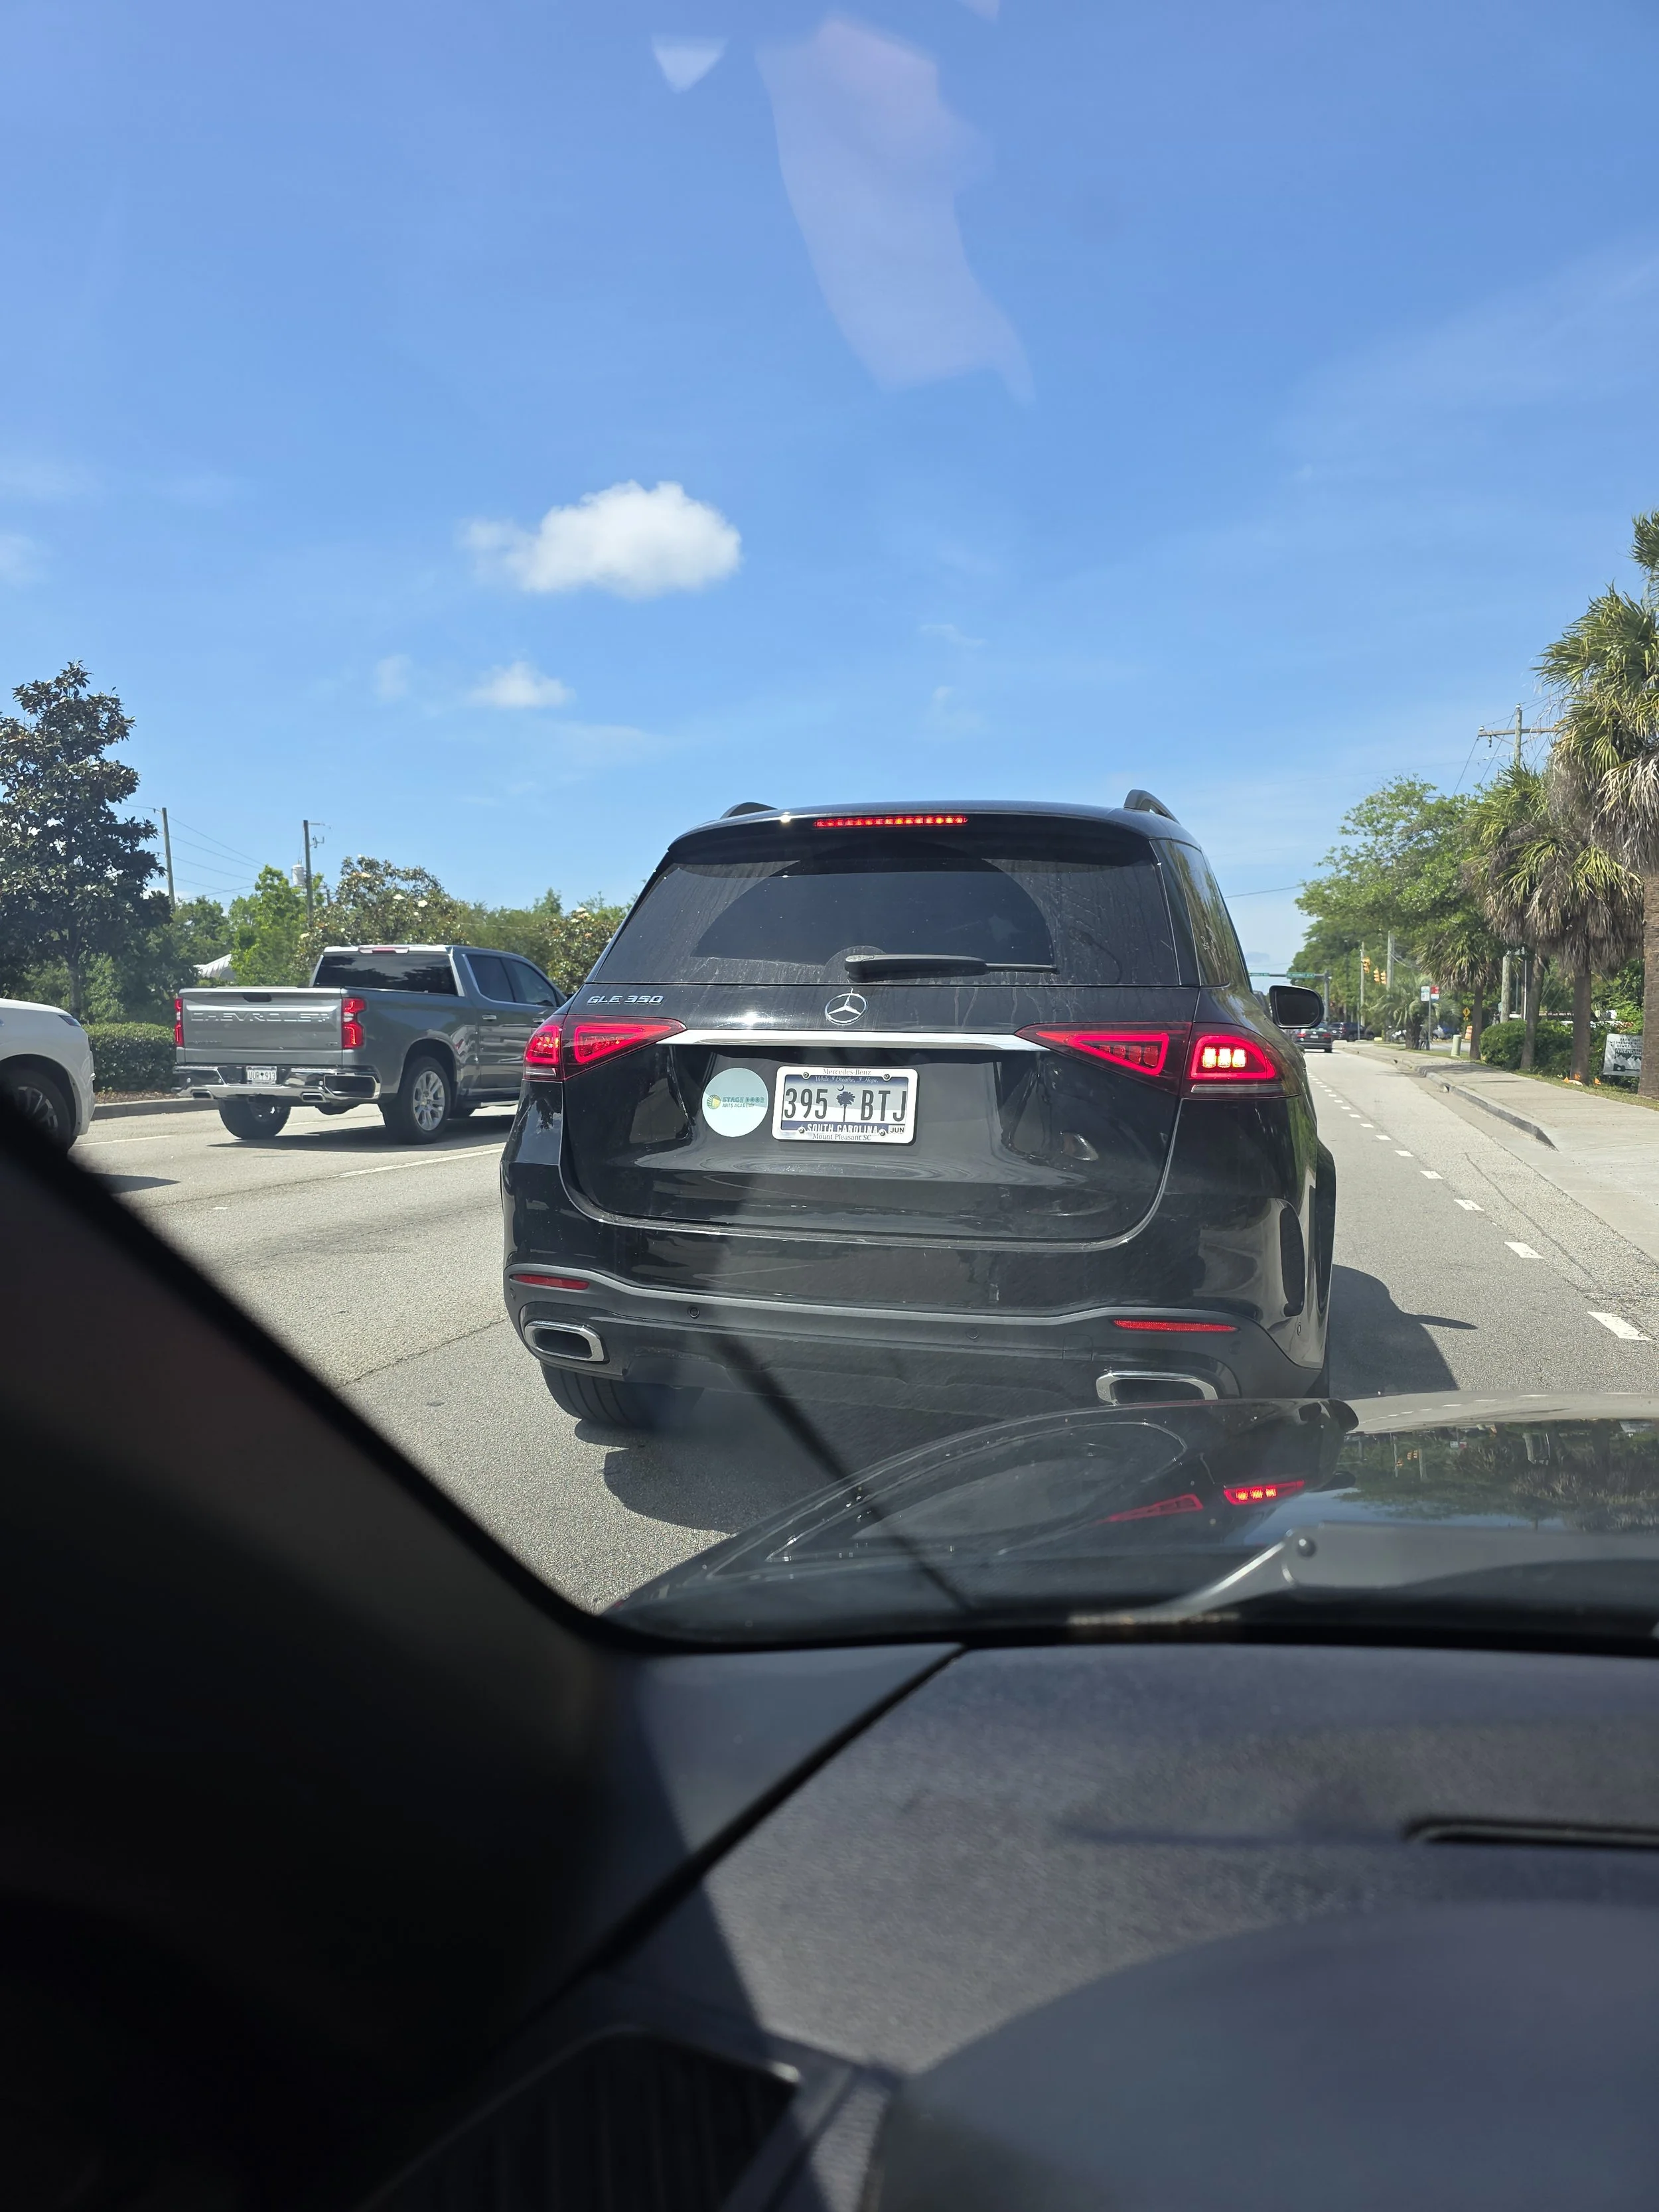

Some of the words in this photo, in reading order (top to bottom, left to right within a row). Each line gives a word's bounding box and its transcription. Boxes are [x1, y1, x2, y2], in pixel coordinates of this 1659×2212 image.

[587, 995, 623, 1004] GLE
[624, 995, 664, 1004] 350
[191, 1013, 330, 1022] CHEVROLET
[784, 1088, 828, 1119] 395
[861, 1089, 907, 1122] BTJ
[807, 1123, 834, 1133] SOUTH
[837, 1124, 879, 1134] CAROLINA
